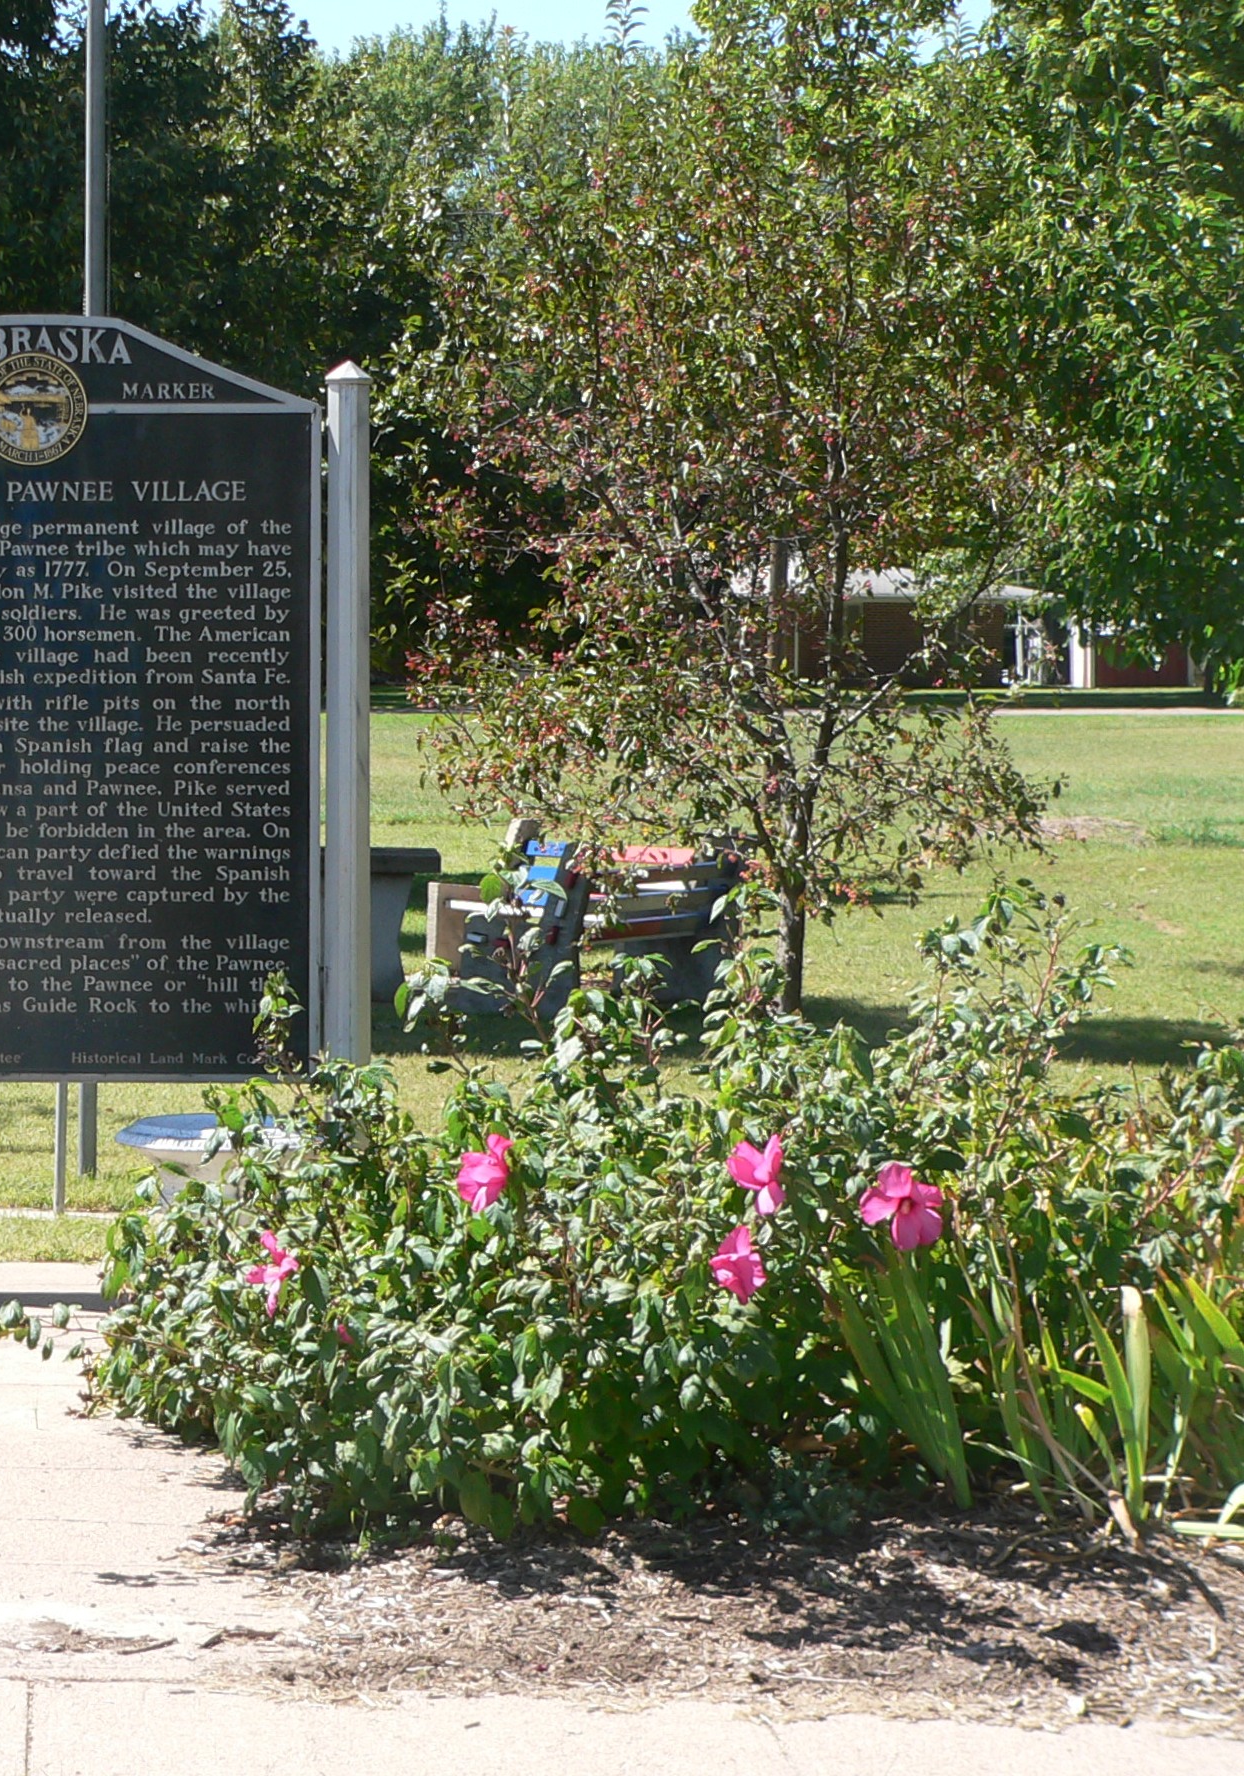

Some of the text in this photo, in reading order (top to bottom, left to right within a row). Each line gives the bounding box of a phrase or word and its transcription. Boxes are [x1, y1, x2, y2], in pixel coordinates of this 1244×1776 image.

[11, 358, 32, 370] THE
[34, 358, 64, 376] STATE
[63, 374, 76, 387] OF
[122, 383, 215, 400] MARKER
[62, 388, 84, 445] NEBRASKA
[7, 481, 113, 502] PAWNEE
[131, 480, 246, 501] VILLAGE
[32, 520, 139, 538] permanent
[152, 518, 215, 538] village
[227, 519, 248, 534] of
[260, 519, 291, 534] the
[16, 566, 35, 577] as
[45, 560, 89, 577] 1777.
[107, 561, 135, 577] On
[145, 561, 253, 580] September
[263, 561, 291, 578] 25,
[3, 625, 37, 641] 300
[44, 626, 142, 642] horsemen.
[154, 625, 191, 641] The
[198, 626, 290, 642] American
[16, 648, 78, 667] village
[94, 647, 129, 663] had
[146, 647, 192, 663] been
[208, 647, 289, 665] recently
[33, 669, 137, 687] expedition
[145, 669, 193, 684] from
[201, 669, 257, 684] Santa
[265, 668, 290, 684] Fe.
[37, 716, 69, 731] the
[77, 716, 143, 735] village.
[156, 715, 182, 731] He
[190, 716, 290, 735] persuaded
[20, 758, 91, 778] holding
[105, 763, 160, 778] peace
[174, 759, 291, 774] conferences
[43, 780, 76, 795] and
[87, 780, 162, 795] Pawnee,
[174, 780, 216, 795] Pike
[226, 780, 290, 795] served
[36, 845, 92, 863] party
[98, 844, 159, 859] defied
[167, 844, 197, 859] the
[204, 845, 290, 863] warnings
[17, 865, 73, 880] travel
[88, 865, 156, 880] toward
[171, 866, 201, 881] the
[216, 865, 289, 884] Spanish
[8, 887, 65, 905] party
[74, 891, 117, 902] were
[127, 887, 214, 905] captured
[224, 887, 249, 905] by
[259, 888, 290, 903] the
[65, 908, 152, 923] released.
[119, 933, 166, 949] from
[181, 934, 211, 949] the
[226, 934, 289, 952] village
[147, 955, 168, 970] of
[177, 955, 208, 970] the
[217, 955, 289, 970] Pawnee.
[23, 997, 77, 1013] Guide
[89, 997, 137, 1013] Rock
[149, 999, 170, 1013] to
[181, 998, 211, 1013] the
[72, 1052, 141, 1064] Historical
[150, 1053, 183, 1064] Land
[193, 1053, 227, 1064] Mark
